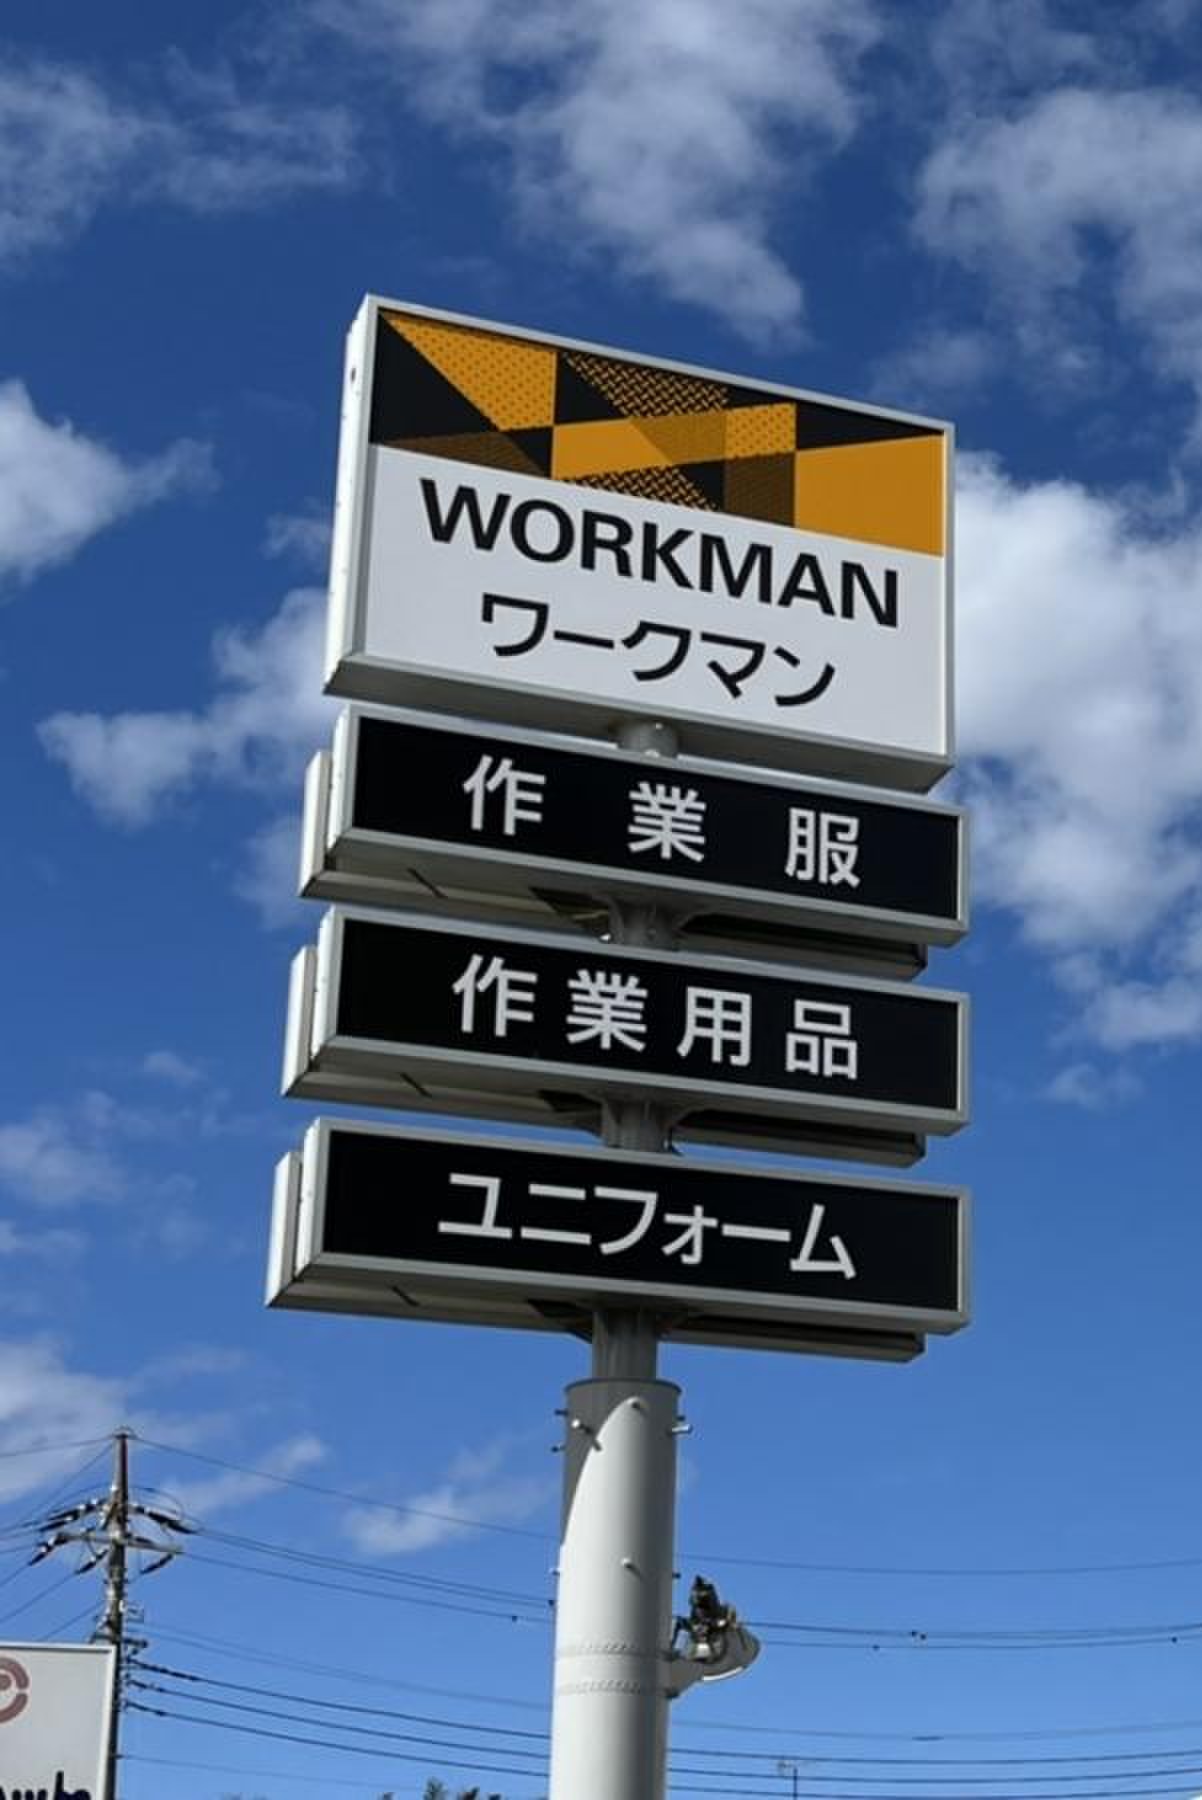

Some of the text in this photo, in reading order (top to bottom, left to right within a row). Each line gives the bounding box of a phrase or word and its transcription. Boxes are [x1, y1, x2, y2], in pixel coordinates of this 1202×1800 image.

[419, 477, 899, 629] WORKMAN
[480, 592, 836, 707] ワークマン
[462, 754, 861, 888] 作業服
[451, 953, 859, 1081] 作業用品
[437, 1172, 857, 1280] ユニフォーム
